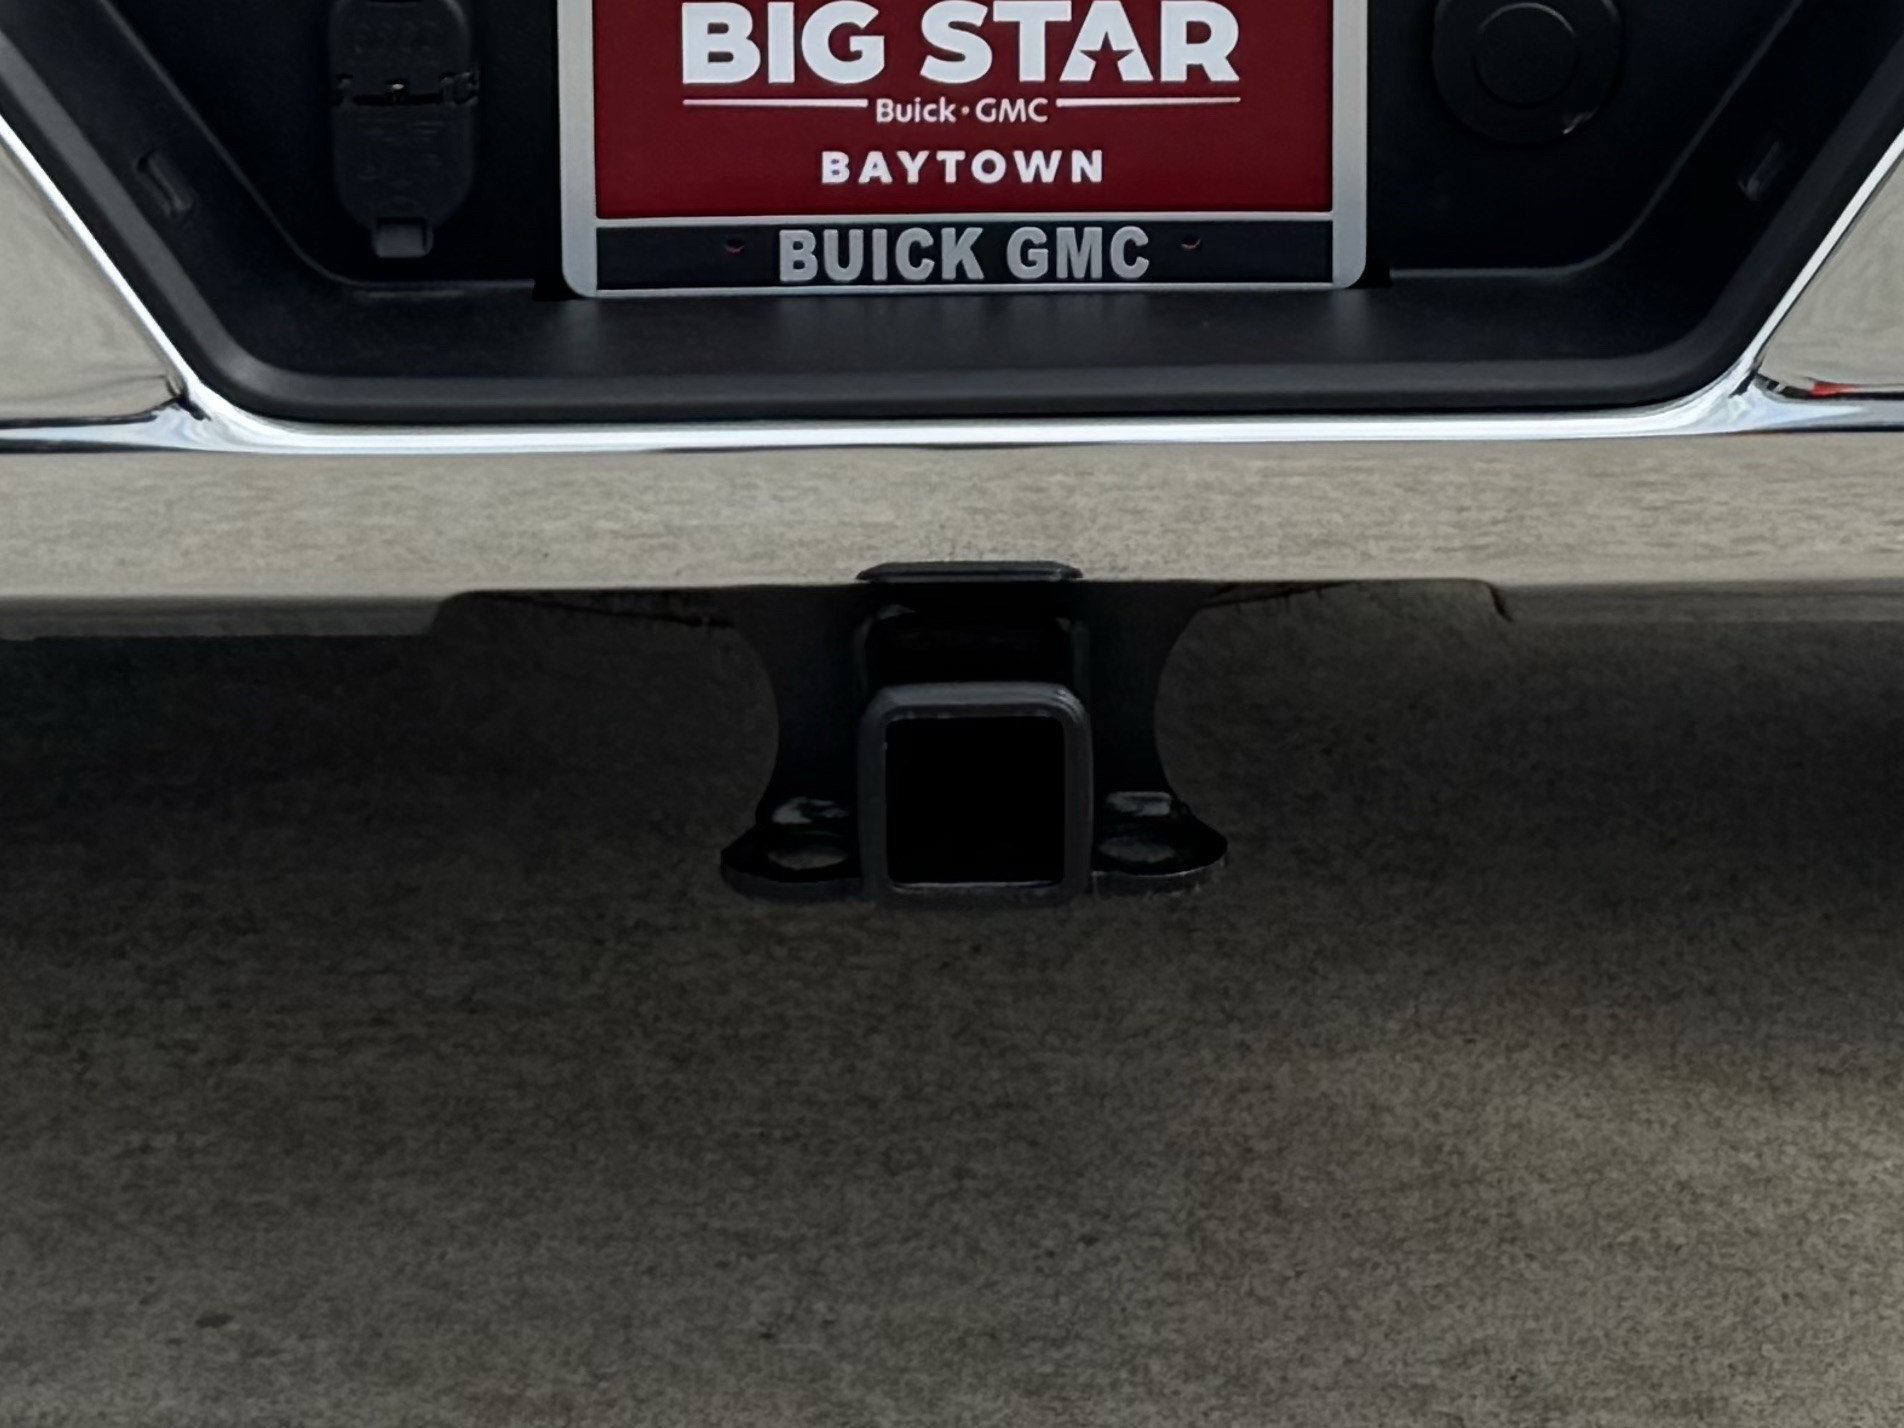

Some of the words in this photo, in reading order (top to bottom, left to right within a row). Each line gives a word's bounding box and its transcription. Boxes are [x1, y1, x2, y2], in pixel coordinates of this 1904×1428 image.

[875, 97, 957, 124] Buick
[975, 97, 1049, 124] GMC
[820, 149, 1104, 185] BAYTOWN
[778, 226, 985, 282] BUICK
[1006, 225, 1150, 280] GMC
